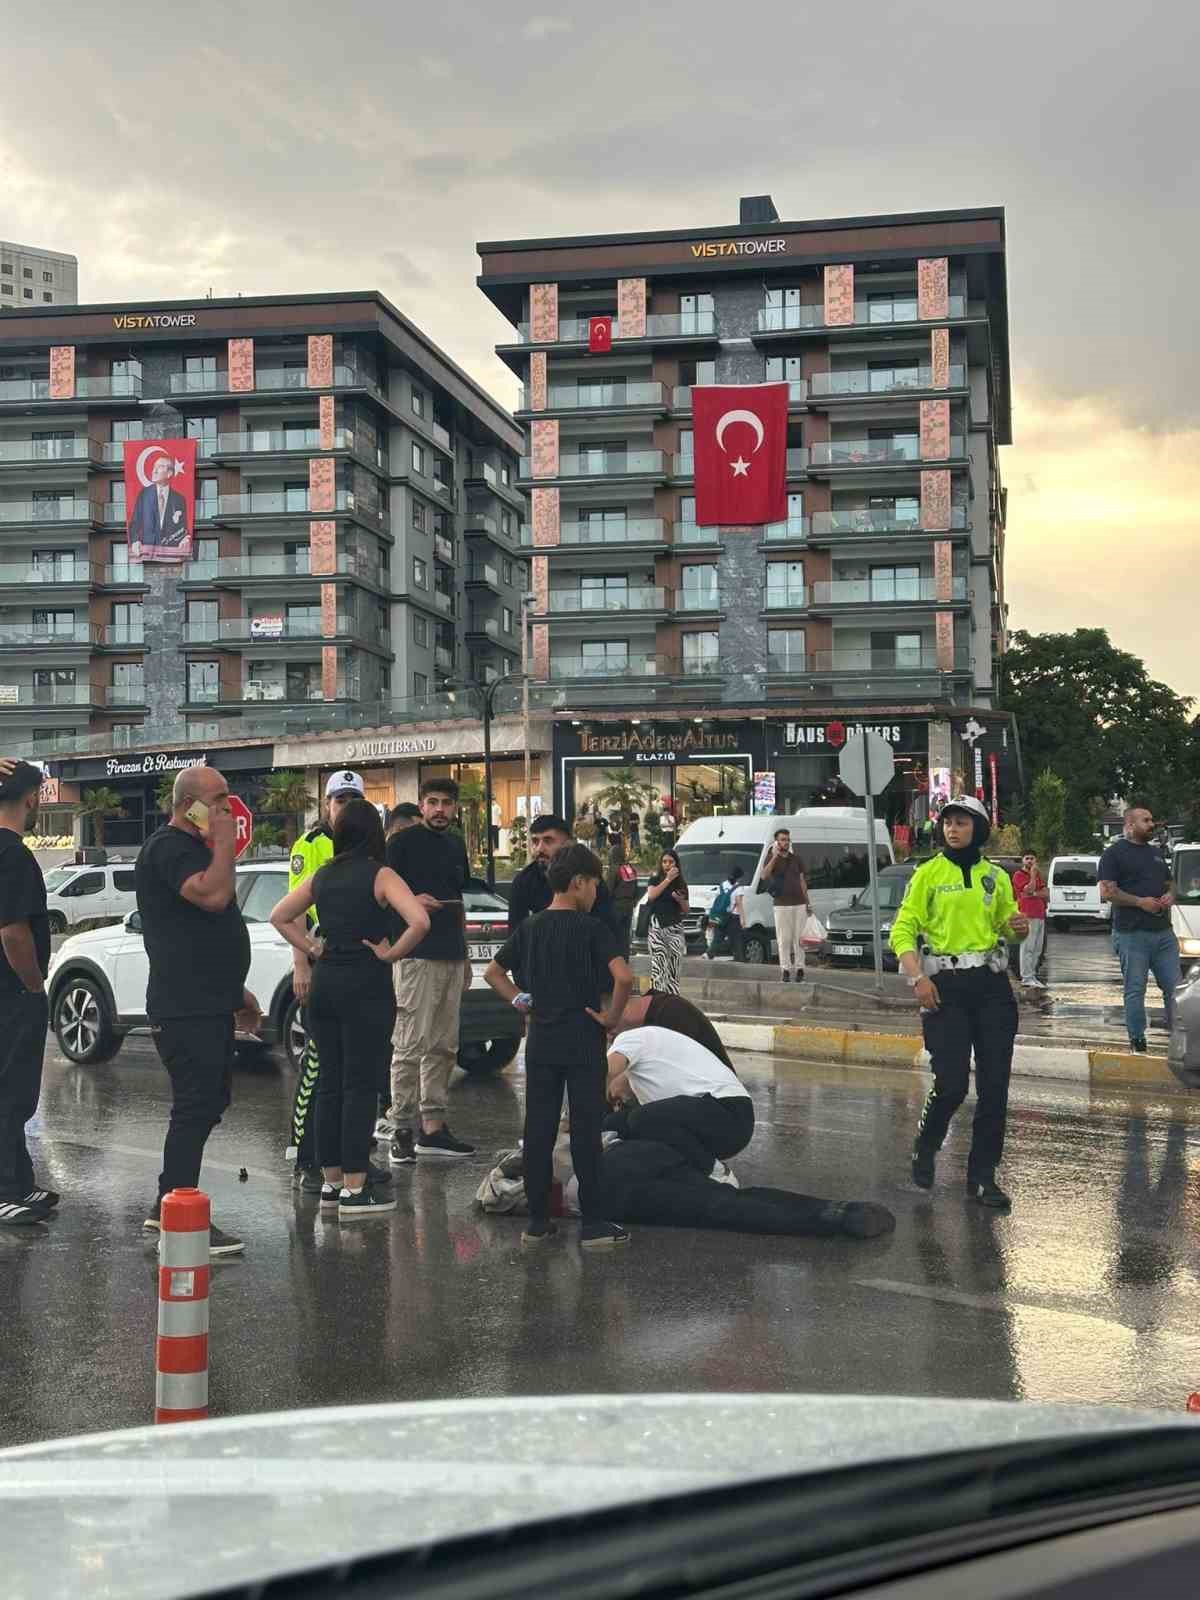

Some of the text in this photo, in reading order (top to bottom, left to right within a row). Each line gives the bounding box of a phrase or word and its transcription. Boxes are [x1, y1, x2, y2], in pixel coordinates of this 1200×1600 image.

[786, 722, 825, 743] HAUS
[360, 738, 435, 757] MULTIBRAND
[635, 751, 676, 761] ELAZIĞ
[155, 753, 208, 771] Restaurant
